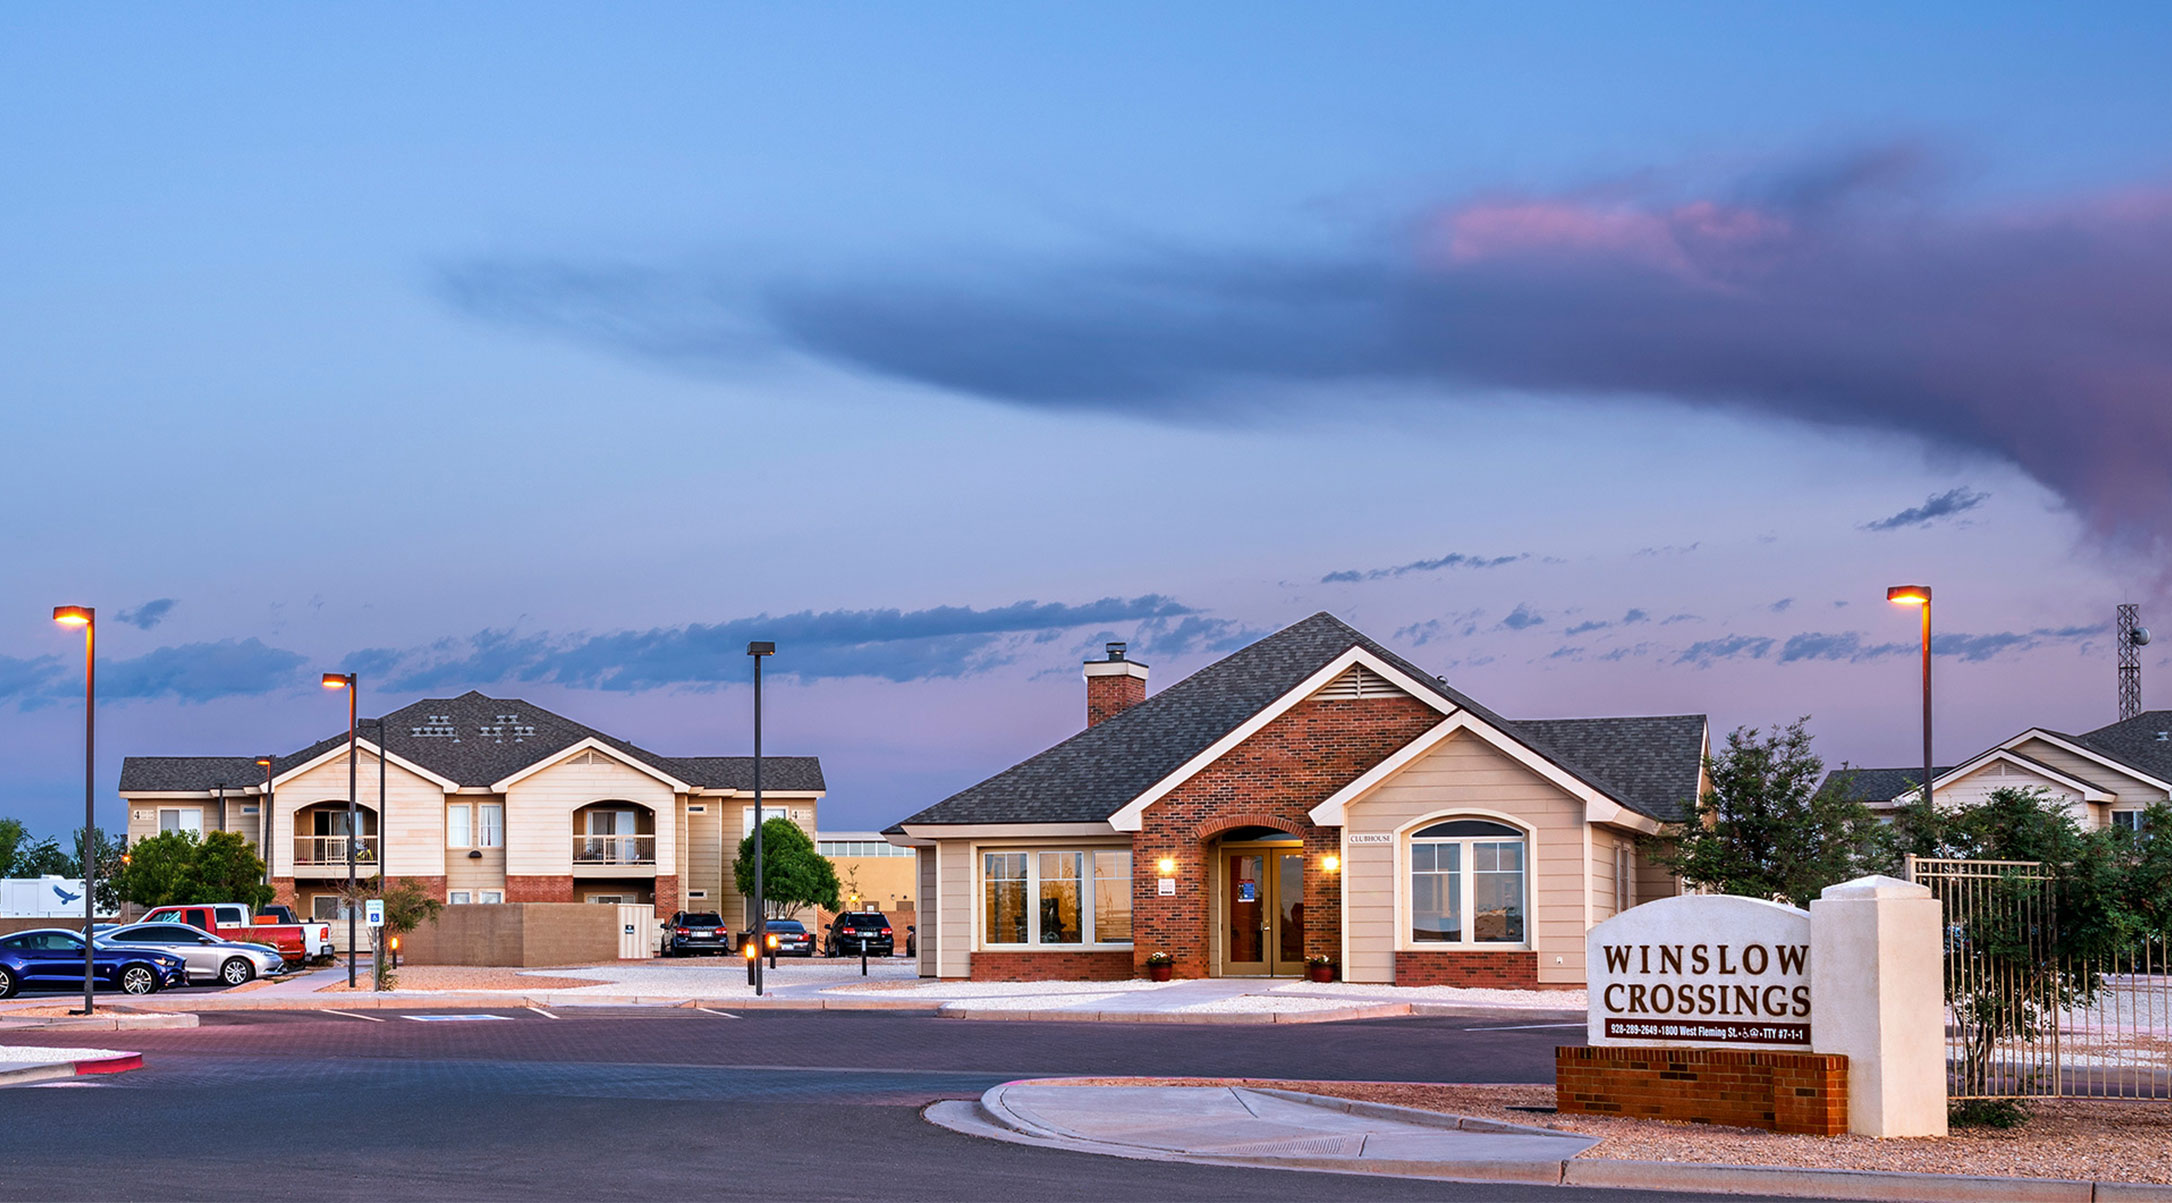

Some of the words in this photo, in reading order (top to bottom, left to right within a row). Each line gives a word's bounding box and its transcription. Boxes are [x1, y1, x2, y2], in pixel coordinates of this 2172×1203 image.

[134, 811, 140, 819] 4
[1603, 944, 1809, 975] WINSLOW
[1603, 983, 1811, 1017] CROSSINGS
[1661, 1025, 1678, 1036] 1800
[1680, 1026, 1697, 1036] West
[1698, 1027, 1726, 1039] Fleming
[1728, 1027, 1738, 1038] St.
[1763, 1029, 1777, 1039] TTY
